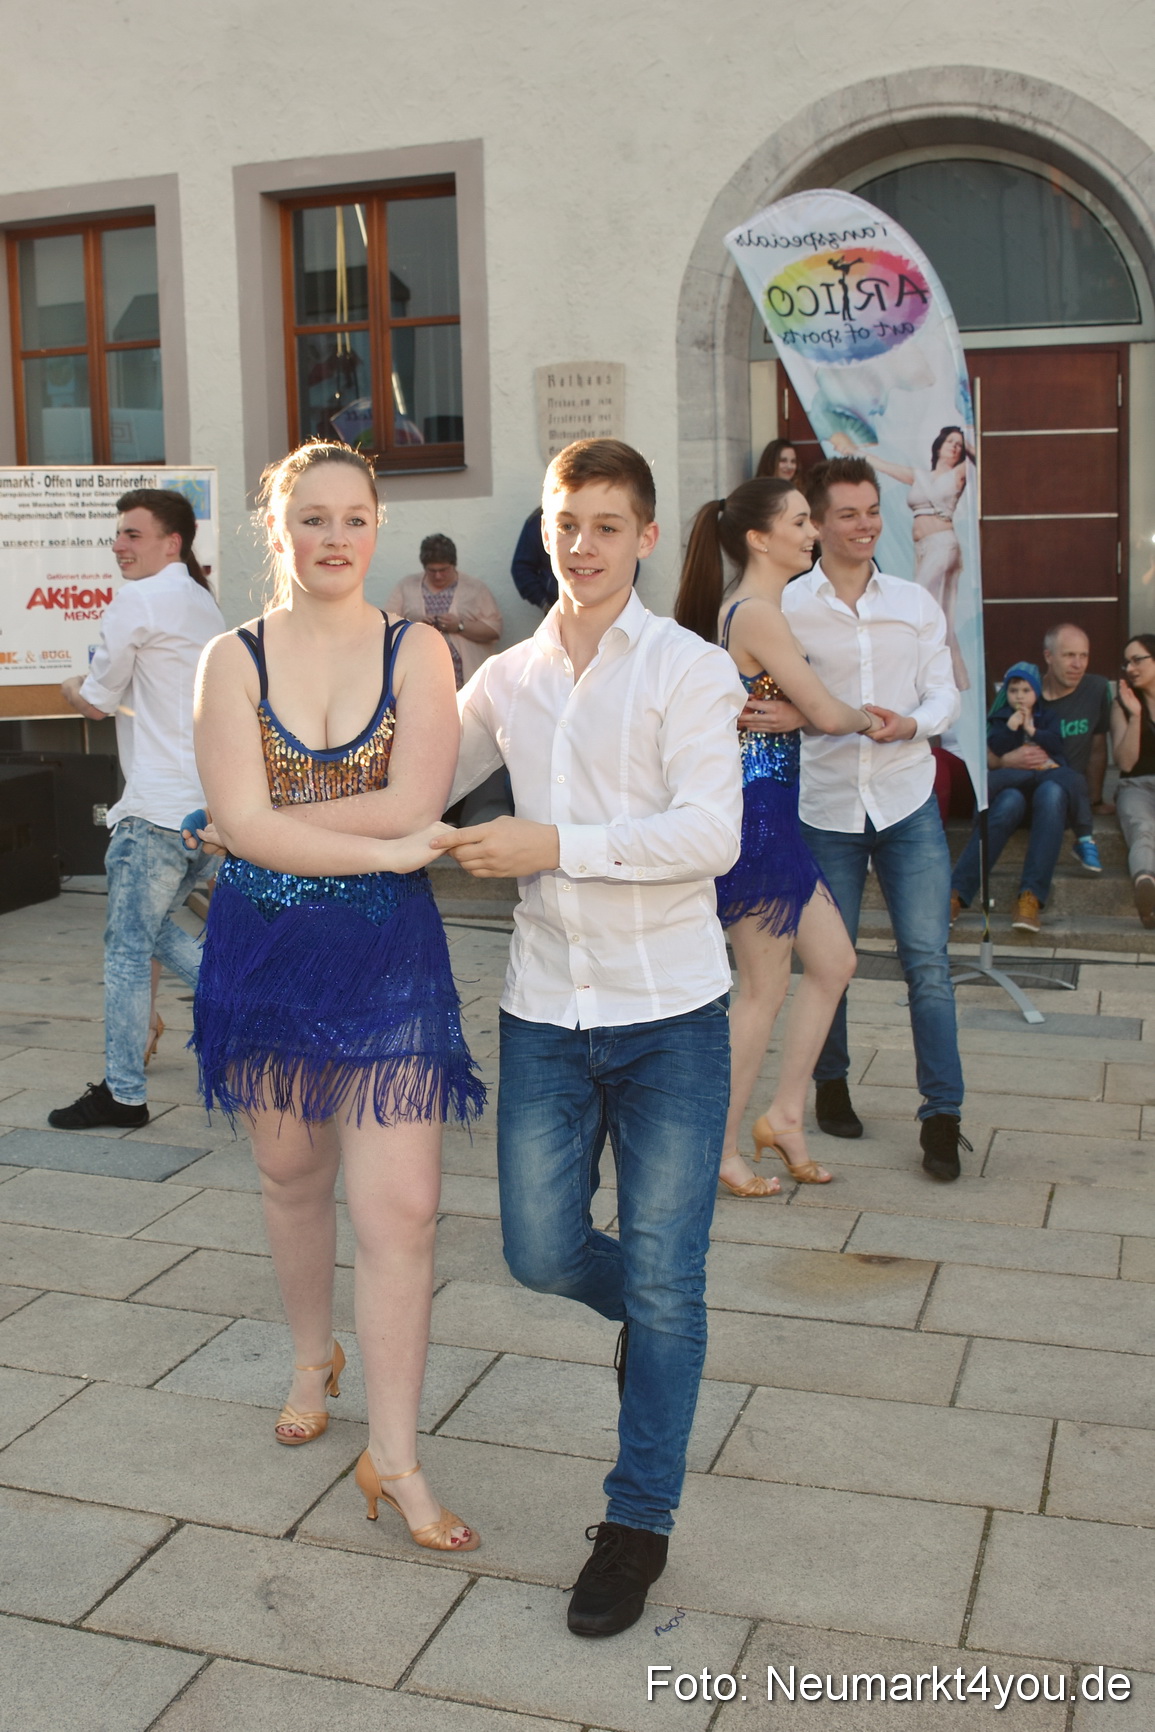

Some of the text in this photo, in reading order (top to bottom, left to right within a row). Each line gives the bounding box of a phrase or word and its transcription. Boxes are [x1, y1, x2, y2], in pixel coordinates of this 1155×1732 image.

[44, 475, 72, 488] Offen
[75, 475, 94, 488] und
[98, 475, 157, 488] Barrierefrei
[48, 537, 93, 547] sozialen
